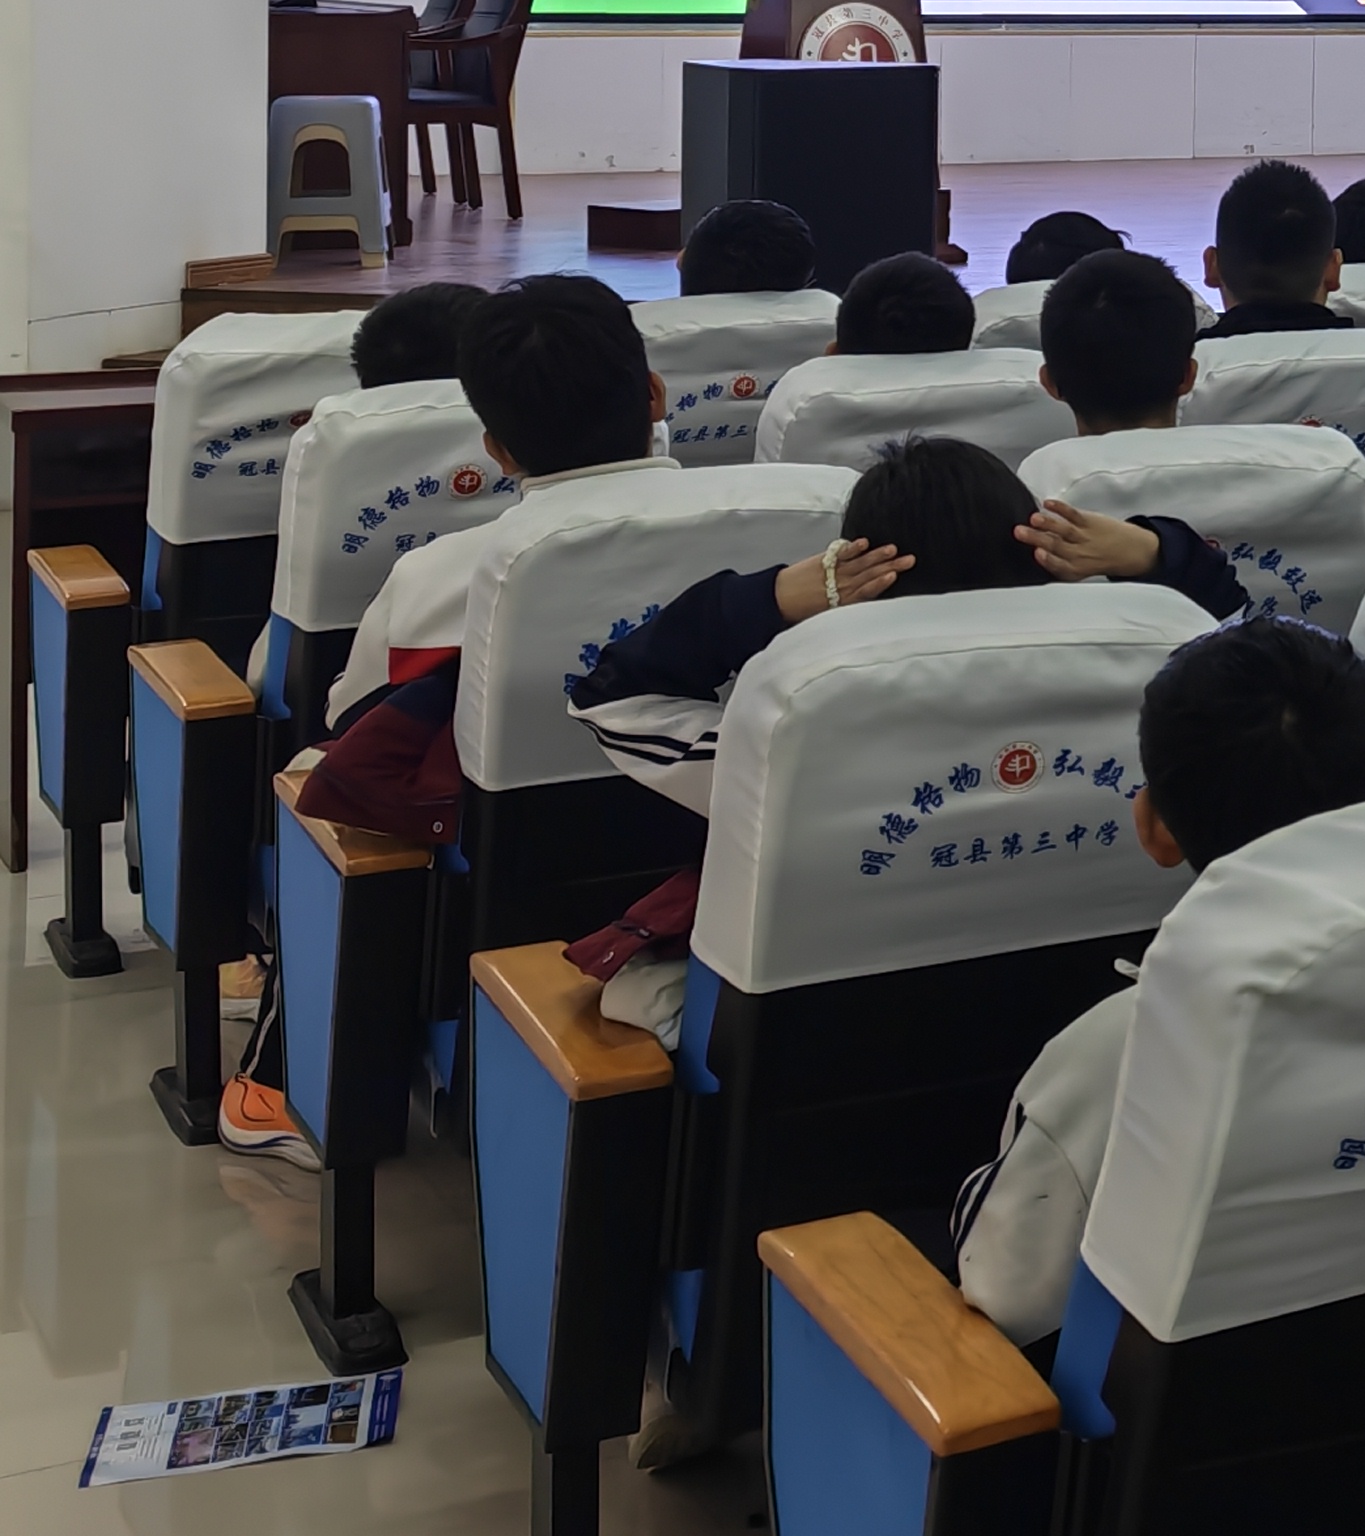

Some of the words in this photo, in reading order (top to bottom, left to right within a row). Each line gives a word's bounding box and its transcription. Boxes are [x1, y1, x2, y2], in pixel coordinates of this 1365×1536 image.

[666, 383, 723, 422] 格物
[673, 425, 755, 443] 冠县第三
[192, 416, 279, 479] 明德格物
[341, 475, 440, 555] 明德格物
[1232, 543, 1323, 615] 弘毅致远
[861, 763, 981, 876] 明德格物
[931, 821, 1117, 868] 冠县第三中学
